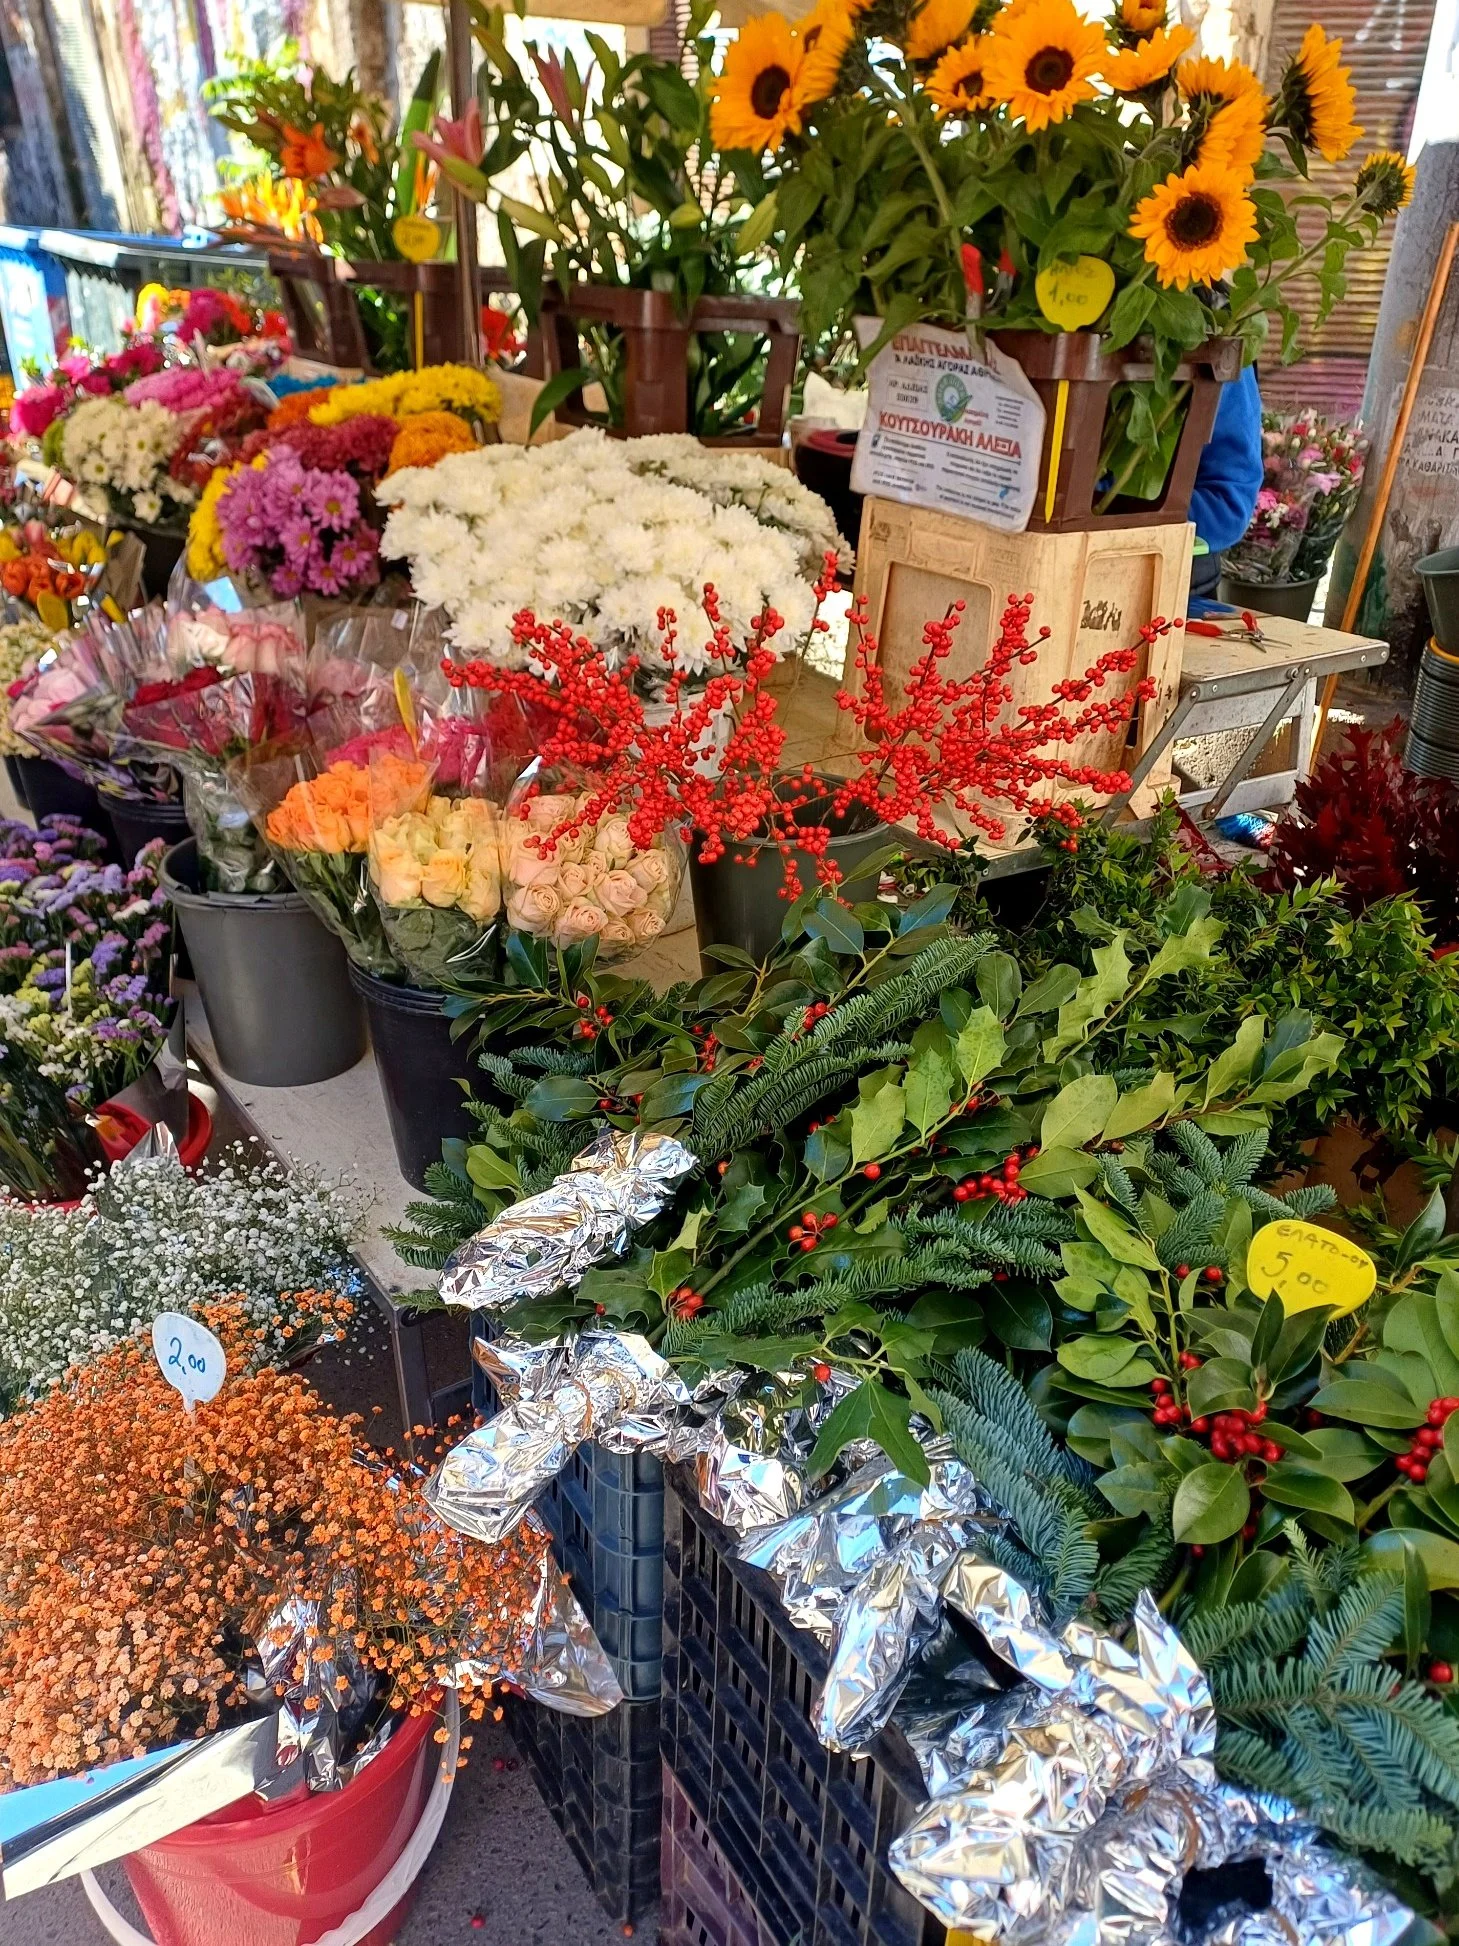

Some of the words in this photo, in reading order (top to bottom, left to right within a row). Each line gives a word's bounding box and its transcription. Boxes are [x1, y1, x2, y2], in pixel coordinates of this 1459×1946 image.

[937, 360, 969, 376] ΑΓΟΡΑΣ
[880, 411, 973, 447] ΚΟΥΤΣΟΥΡΑΚΗ
[1261, 1251, 1328, 1294] 5,00
[168, 1337, 206, 1375] 2,00
